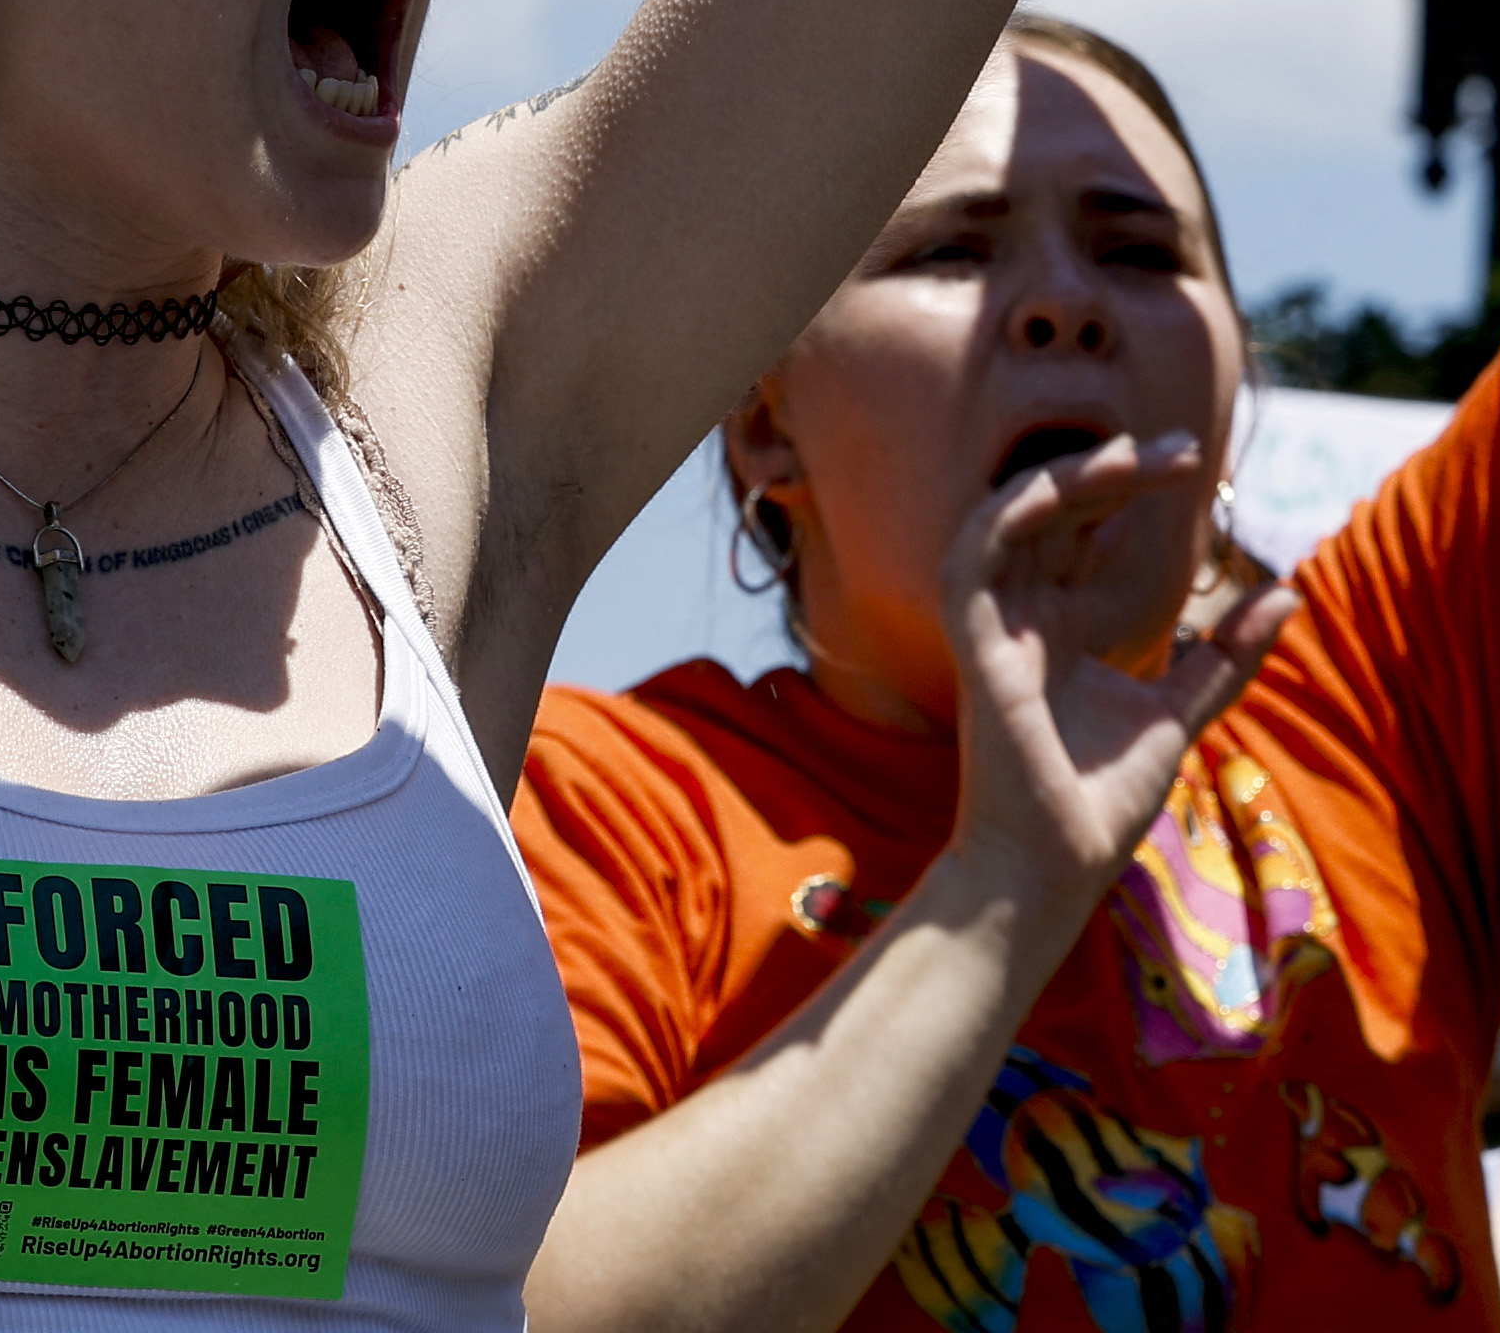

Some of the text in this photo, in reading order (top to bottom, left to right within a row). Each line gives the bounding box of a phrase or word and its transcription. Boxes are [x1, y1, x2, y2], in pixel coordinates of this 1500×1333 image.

[98, 551, 128, 574] OF
[133, 525, 233, 569] KINGDOMS
[73, 1048, 321, 1137] FEMALE
[31, 1216, 326, 1242] #RiseUp4AbortionRights #Green4Abortion
[21, 1235, 321, 1273] RiseUp4AbortionRights.org
